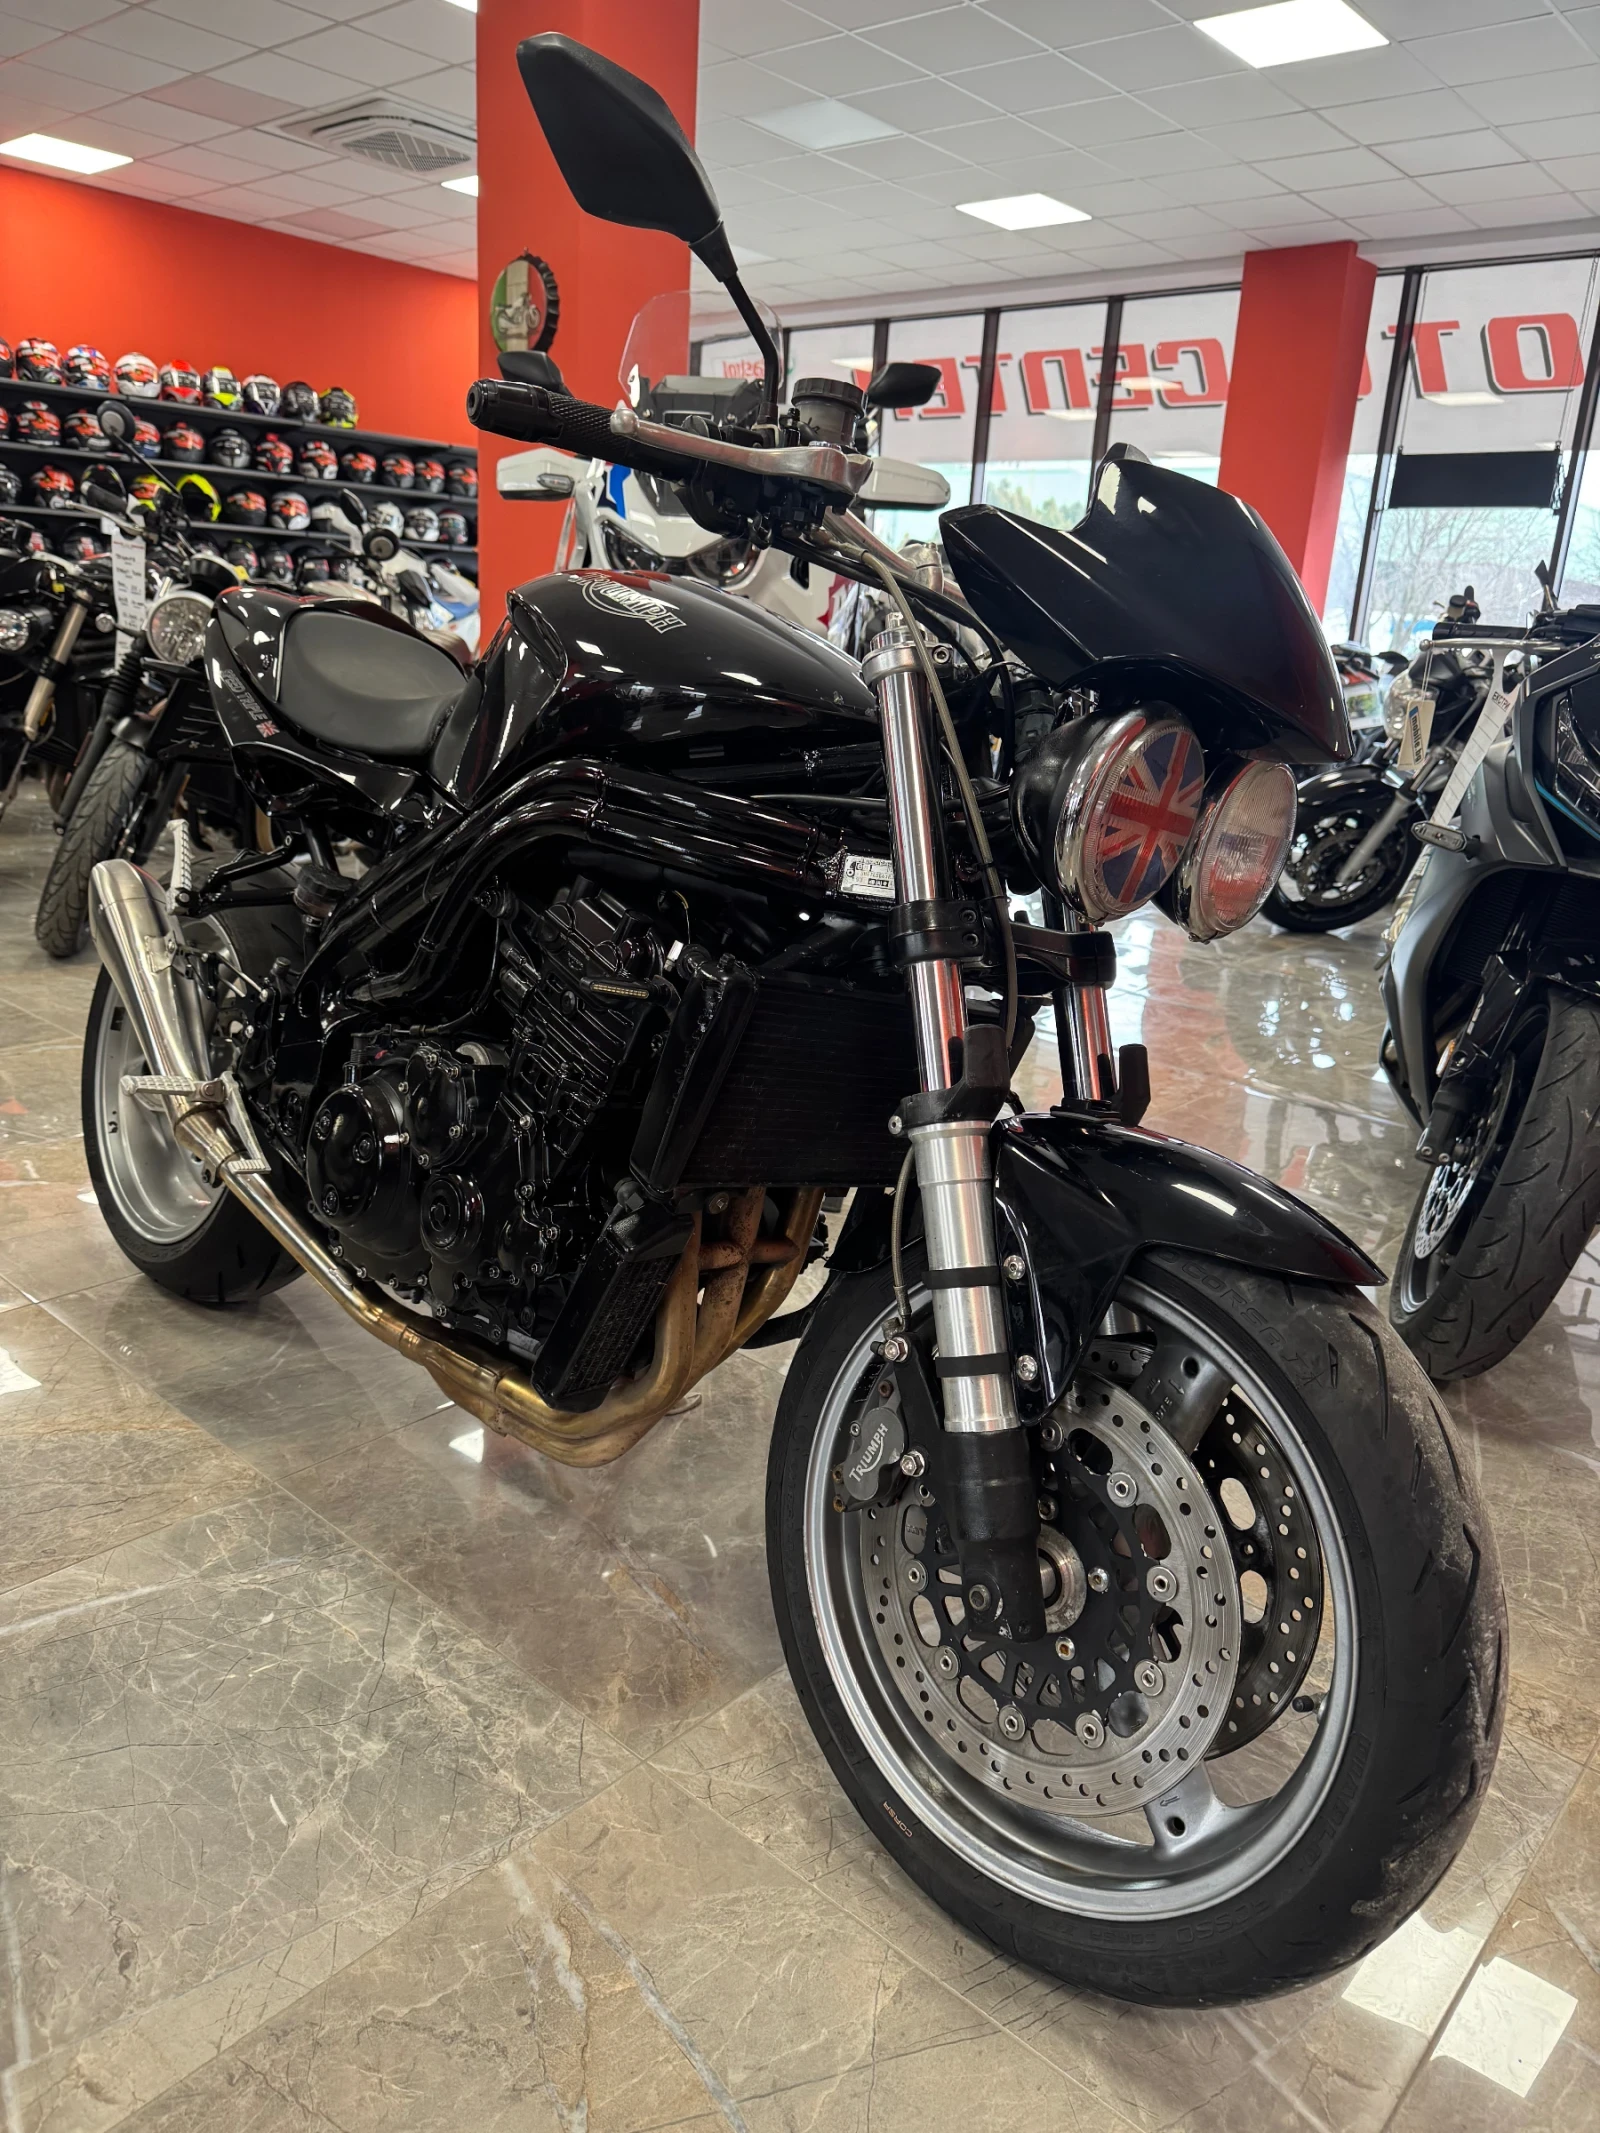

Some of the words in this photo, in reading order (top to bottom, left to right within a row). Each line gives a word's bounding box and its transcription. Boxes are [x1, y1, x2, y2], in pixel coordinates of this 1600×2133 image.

[567, 571, 688, 634] TRIUMPH
[221, 668, 246, 693] SPEED
[236, 691, 268, 721] TRIPLE
[1411, 716, 1422, 762] mobile.bg
[848, 1422, 889, 1483] TRIUMPH
[881, 1800, 914, 1839] CORSA
